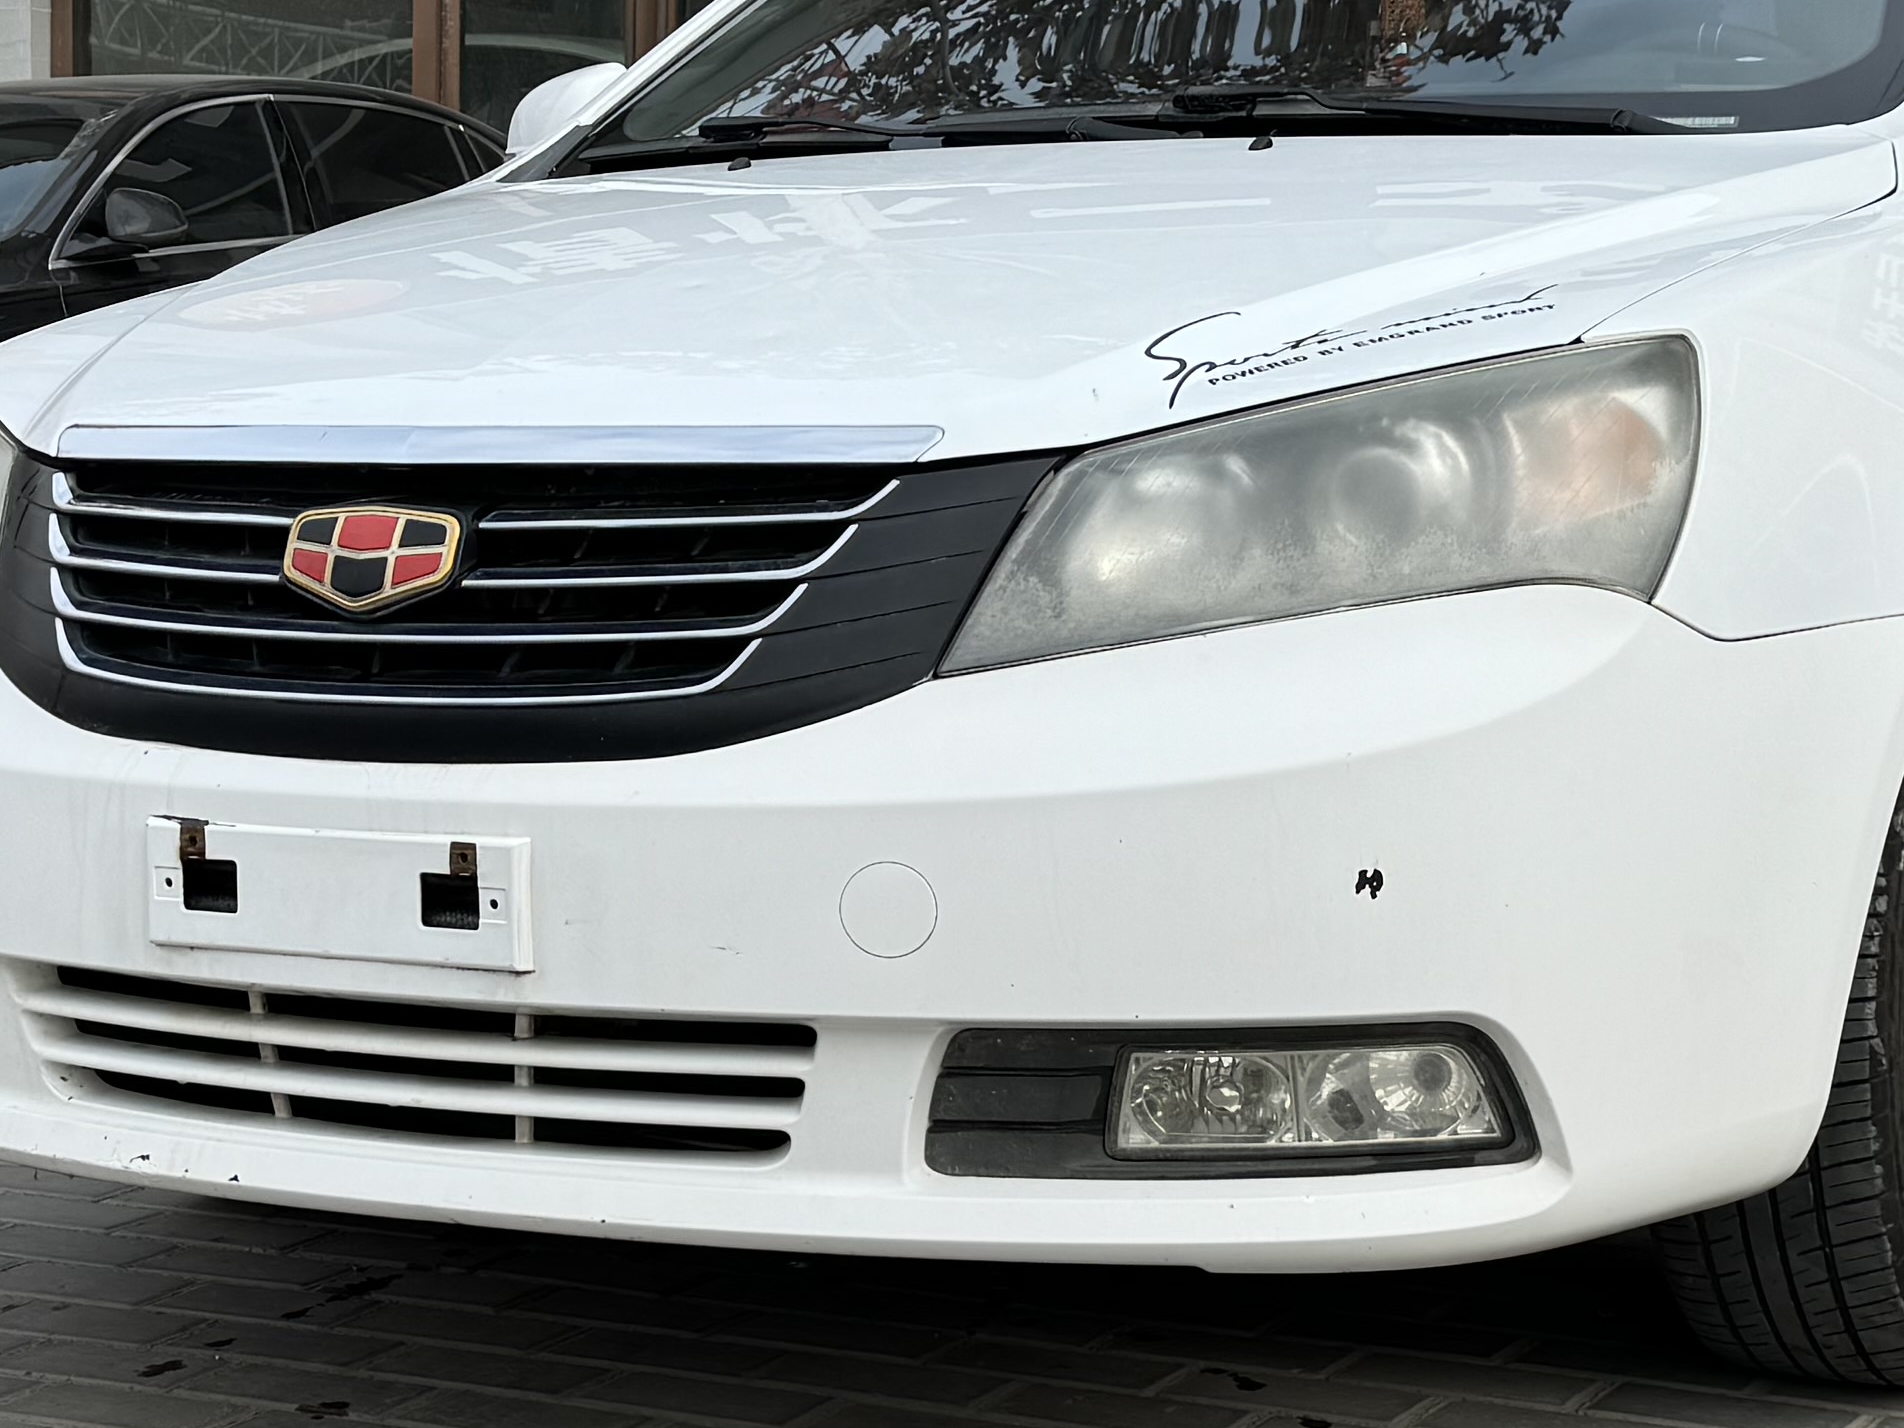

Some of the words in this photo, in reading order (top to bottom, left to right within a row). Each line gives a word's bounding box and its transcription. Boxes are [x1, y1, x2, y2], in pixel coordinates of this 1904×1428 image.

[1207, 355, 1309, 387] POWERED
[1318, 345, 1345, 358] BY
[1352, 318, 1474, 349] EMGRAND
[1481, 303, 1557, 321] SPORT
